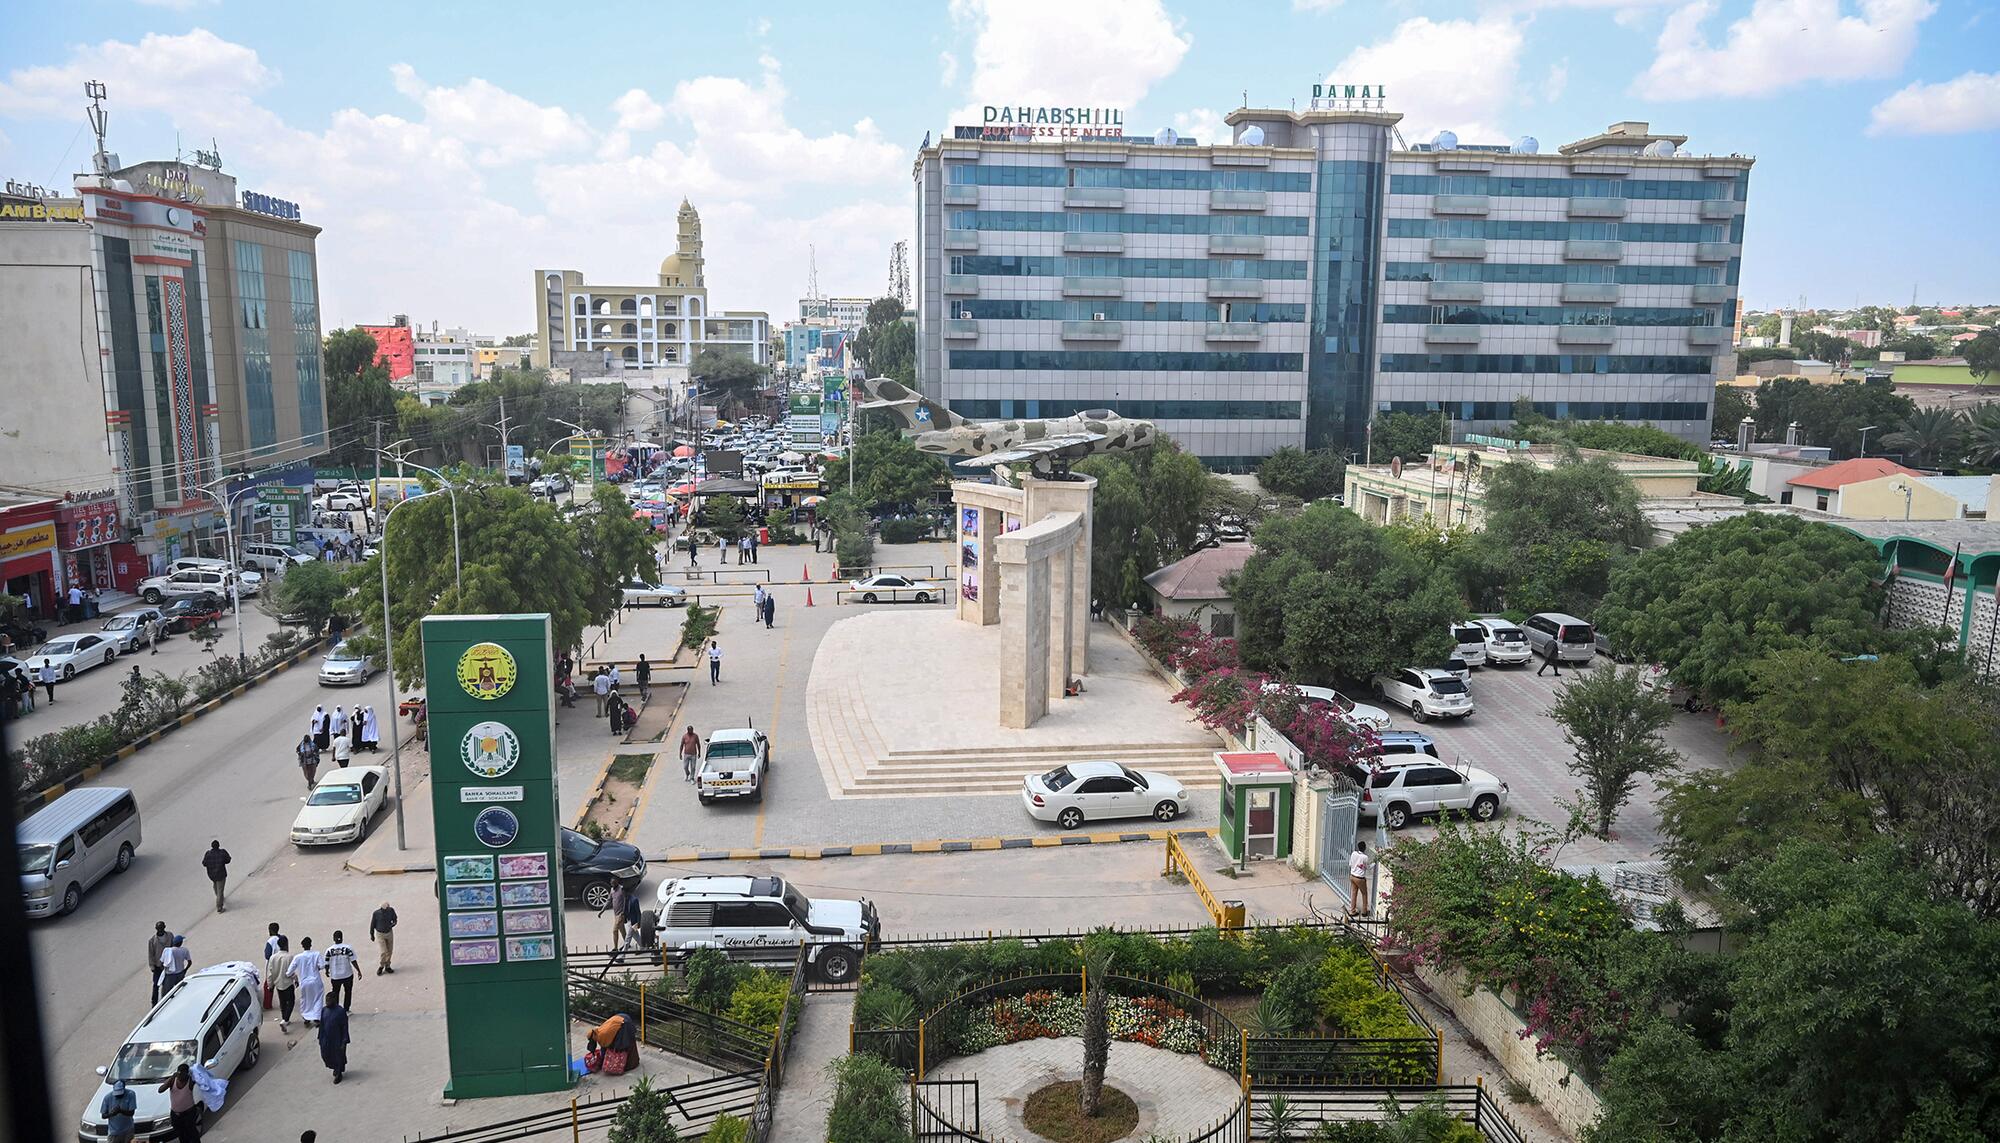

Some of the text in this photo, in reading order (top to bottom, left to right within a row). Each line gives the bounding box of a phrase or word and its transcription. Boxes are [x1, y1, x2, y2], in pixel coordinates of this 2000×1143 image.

[1313, 85, 1386, 98] DAMAL
[1311, 99, 1384, 109] HOTEL
[984, 105, 1123, 125] DAHABSHIIL
[983, 126, 1122, 137] BUSINESS CENTER
[244, 190, 301, 218] SAMSUNG
[725, 937, 795, 946] Land Cruiser
